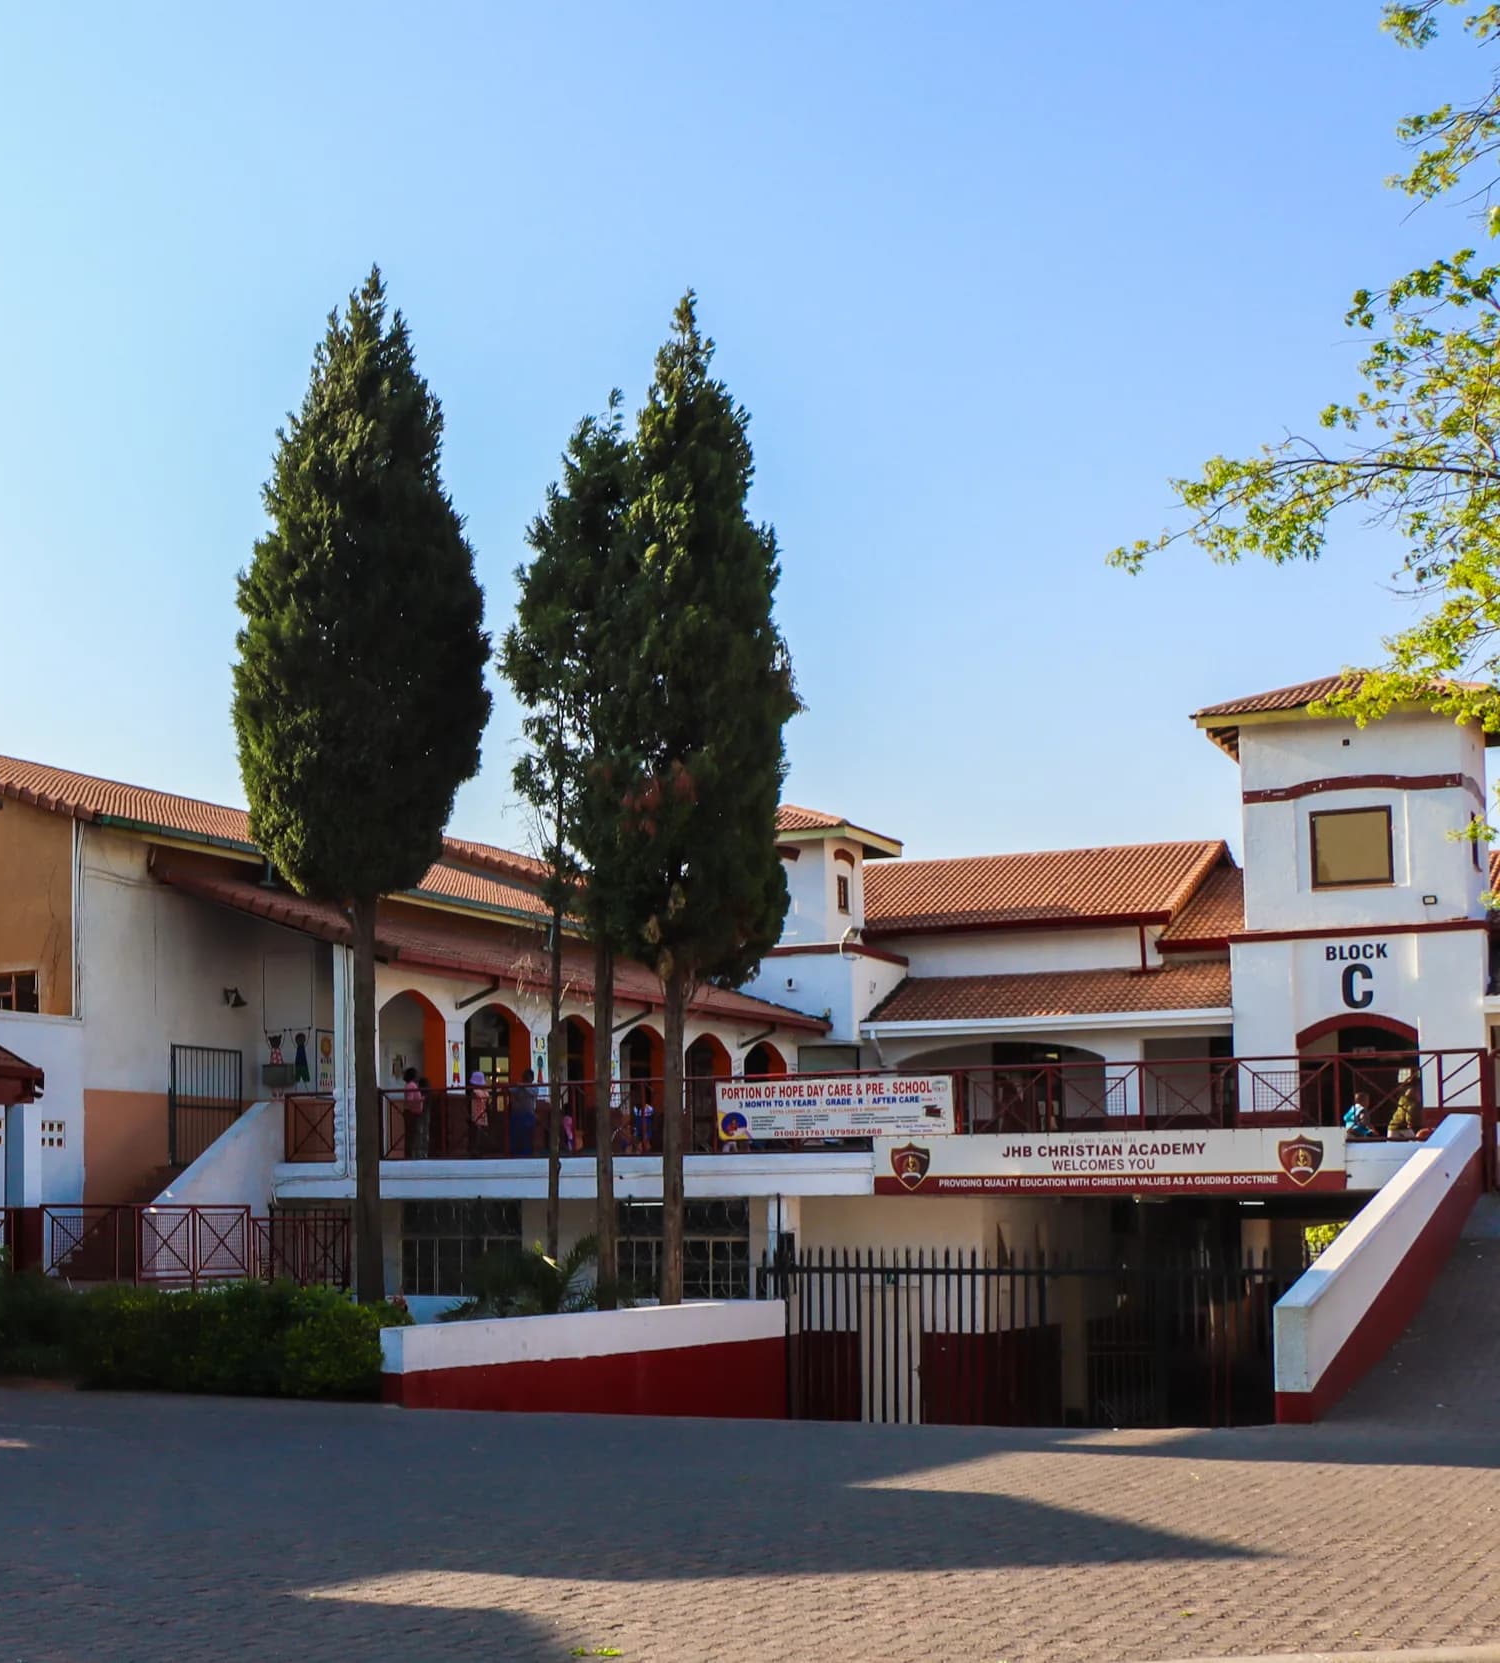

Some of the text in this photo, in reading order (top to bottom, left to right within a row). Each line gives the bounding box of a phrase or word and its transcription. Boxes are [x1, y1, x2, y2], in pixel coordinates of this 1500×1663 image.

[1325, 943, 1388, 961] BLOCK
[1342, 963, 1373, 1009] C
[721, 1086, 761, 1099] PORTION
[765, 1086, 776, 1098] OF
[780, 1085, 804, 1098] HOPE
[807, 1084, 824, 1097] DAY
[827, 1083, 852, 1096] CARE
[856, 1083, 862, 1095] &
[866, 1082, 884, 1095] PRE
[893, 1080, 932, 1094] SCHOOL
[745, 1100, 771, 1108] MONTH
[774, 1099, 784, 1107] TO
[792, 1099, 817, 1107] YEARS
[826, 1097, 851, 1106] GRADE
[872, 1096, 896, 1104] AFTER
[899, 1095, 919, 1103] CARE
[1002, 1142, 1206, 1158] JHB CHRISTIAN ACADEMY
[1051, 1158, 1155, 1171] WELCOMES YOU
[939, 1175, 1278, 1188] PROVIDING QUALITY EDUCATION WITH CHRISTIAN VALUES AS A GUIDING DOCTRINE
